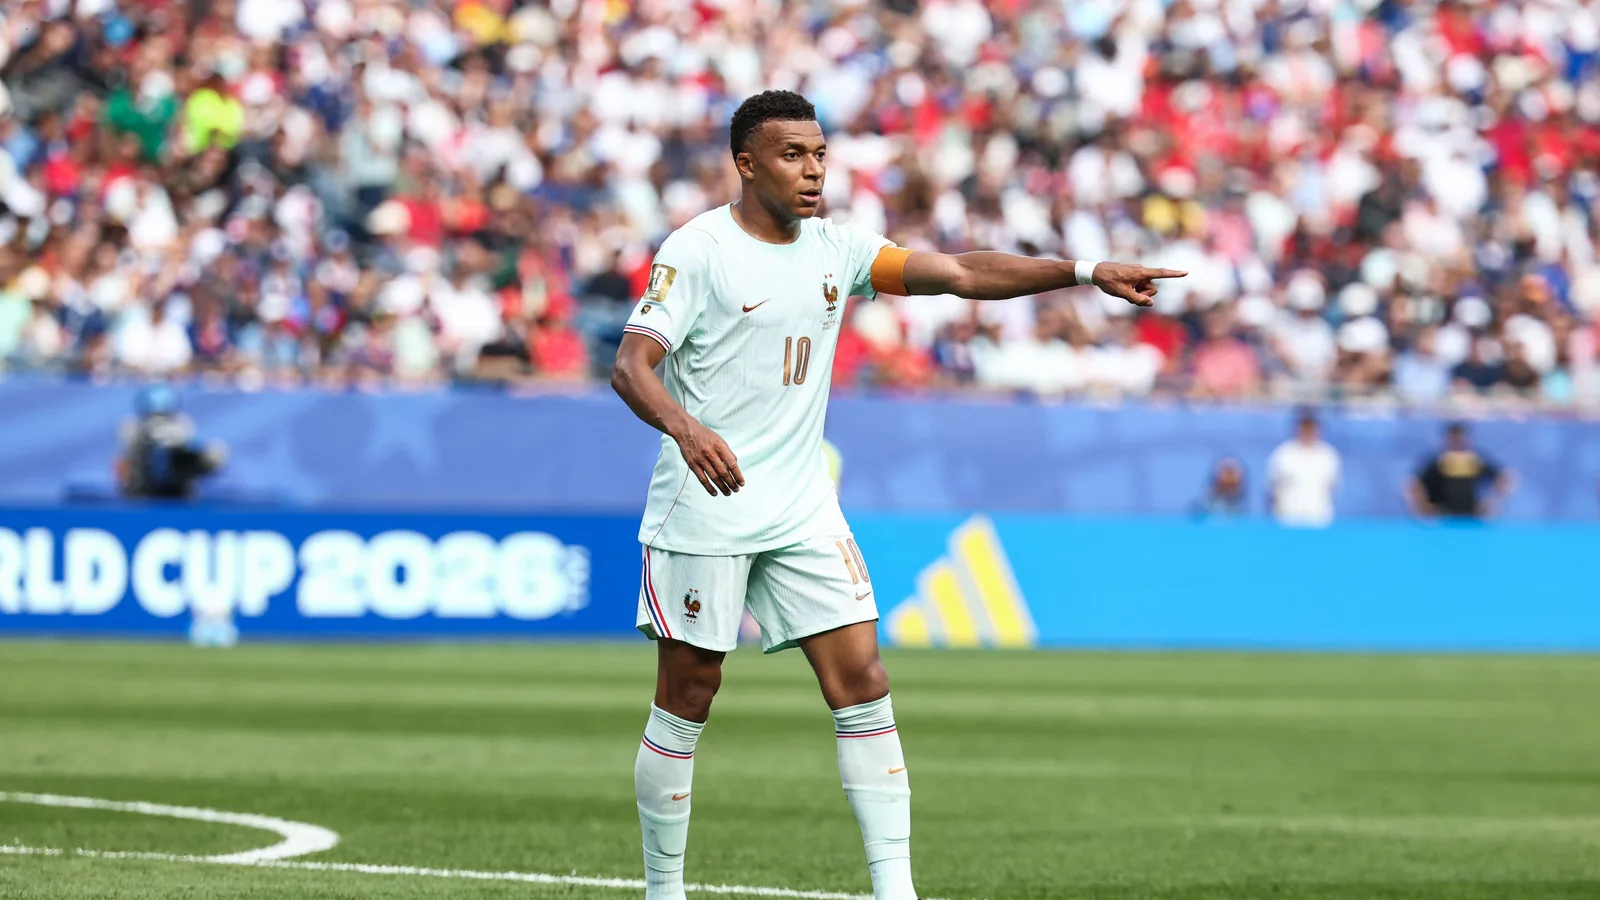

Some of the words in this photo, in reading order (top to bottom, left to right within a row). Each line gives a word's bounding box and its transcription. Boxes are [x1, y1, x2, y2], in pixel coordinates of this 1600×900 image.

[783, 336, 811, 386] 10
[131, 528, 297, 618] CUP
[297, 529, 568, 620] 2026
[835, 538, 869, 585] 10
